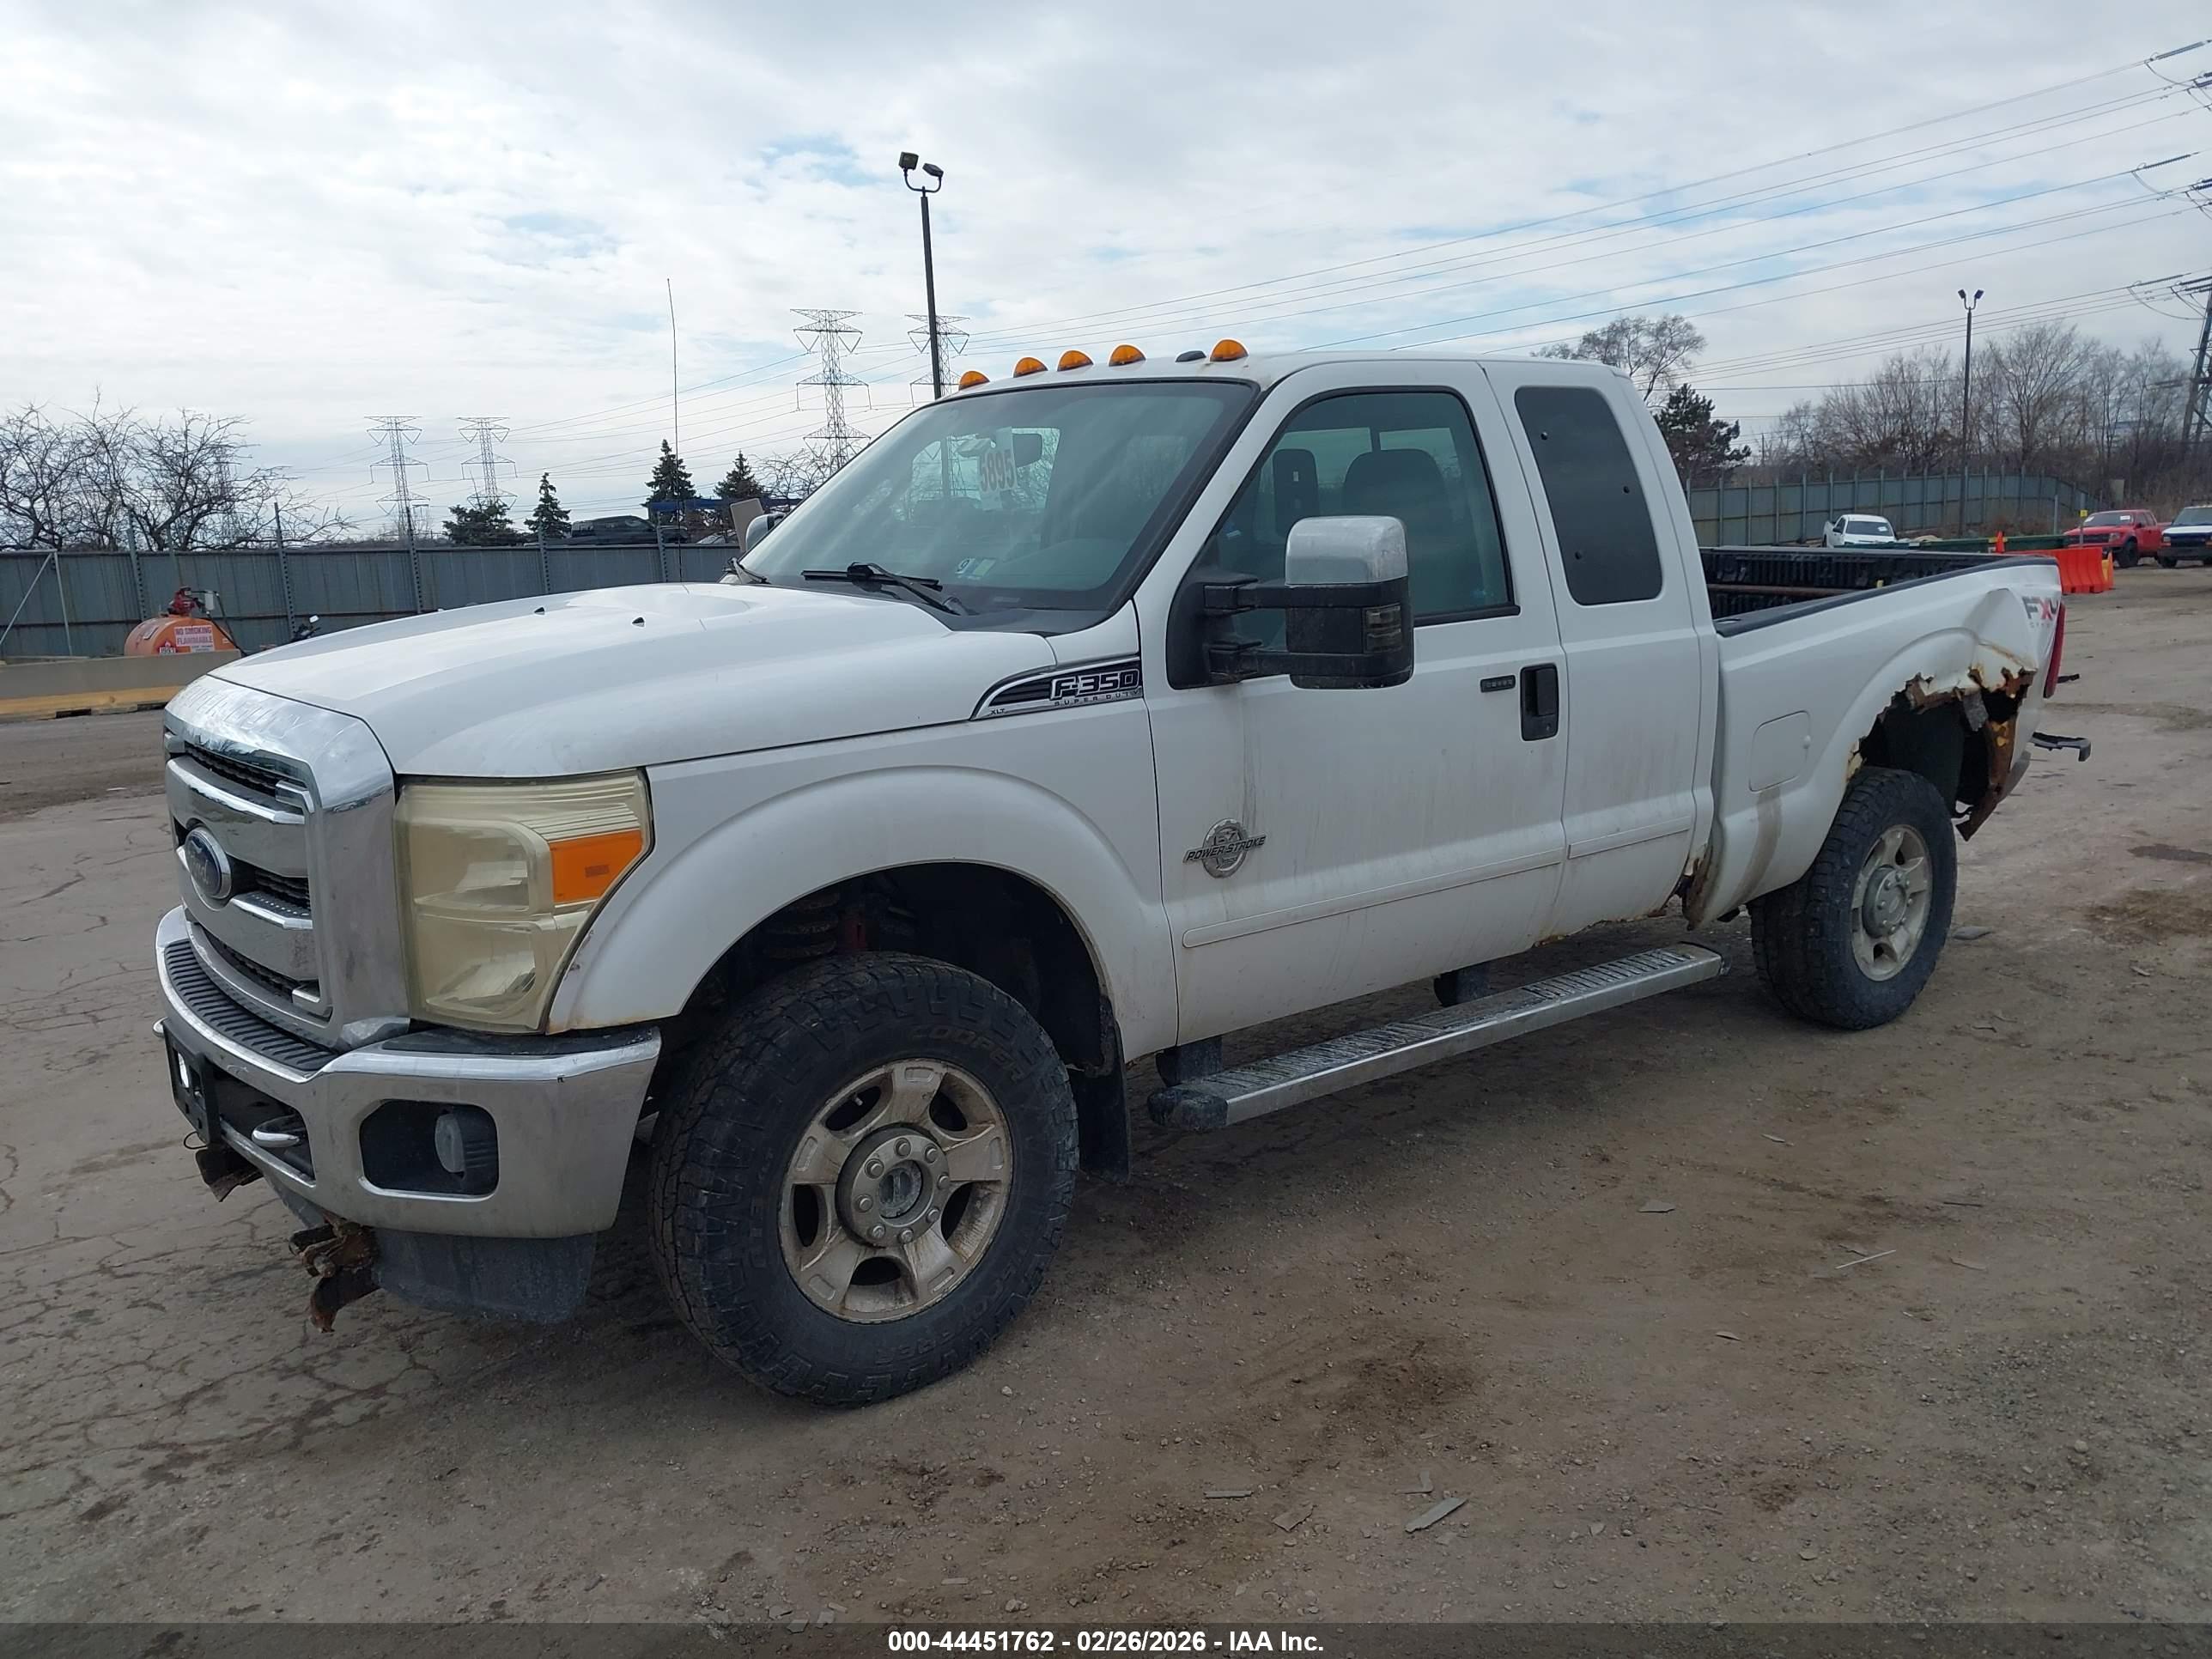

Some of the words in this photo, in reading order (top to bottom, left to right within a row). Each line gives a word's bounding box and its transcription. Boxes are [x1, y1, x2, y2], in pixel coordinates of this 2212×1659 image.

[1054, 696, 1098, 708] SUPER
[1105, 690, 1140, 701] DUTY
[990, 708, 1006, 716] XLT
